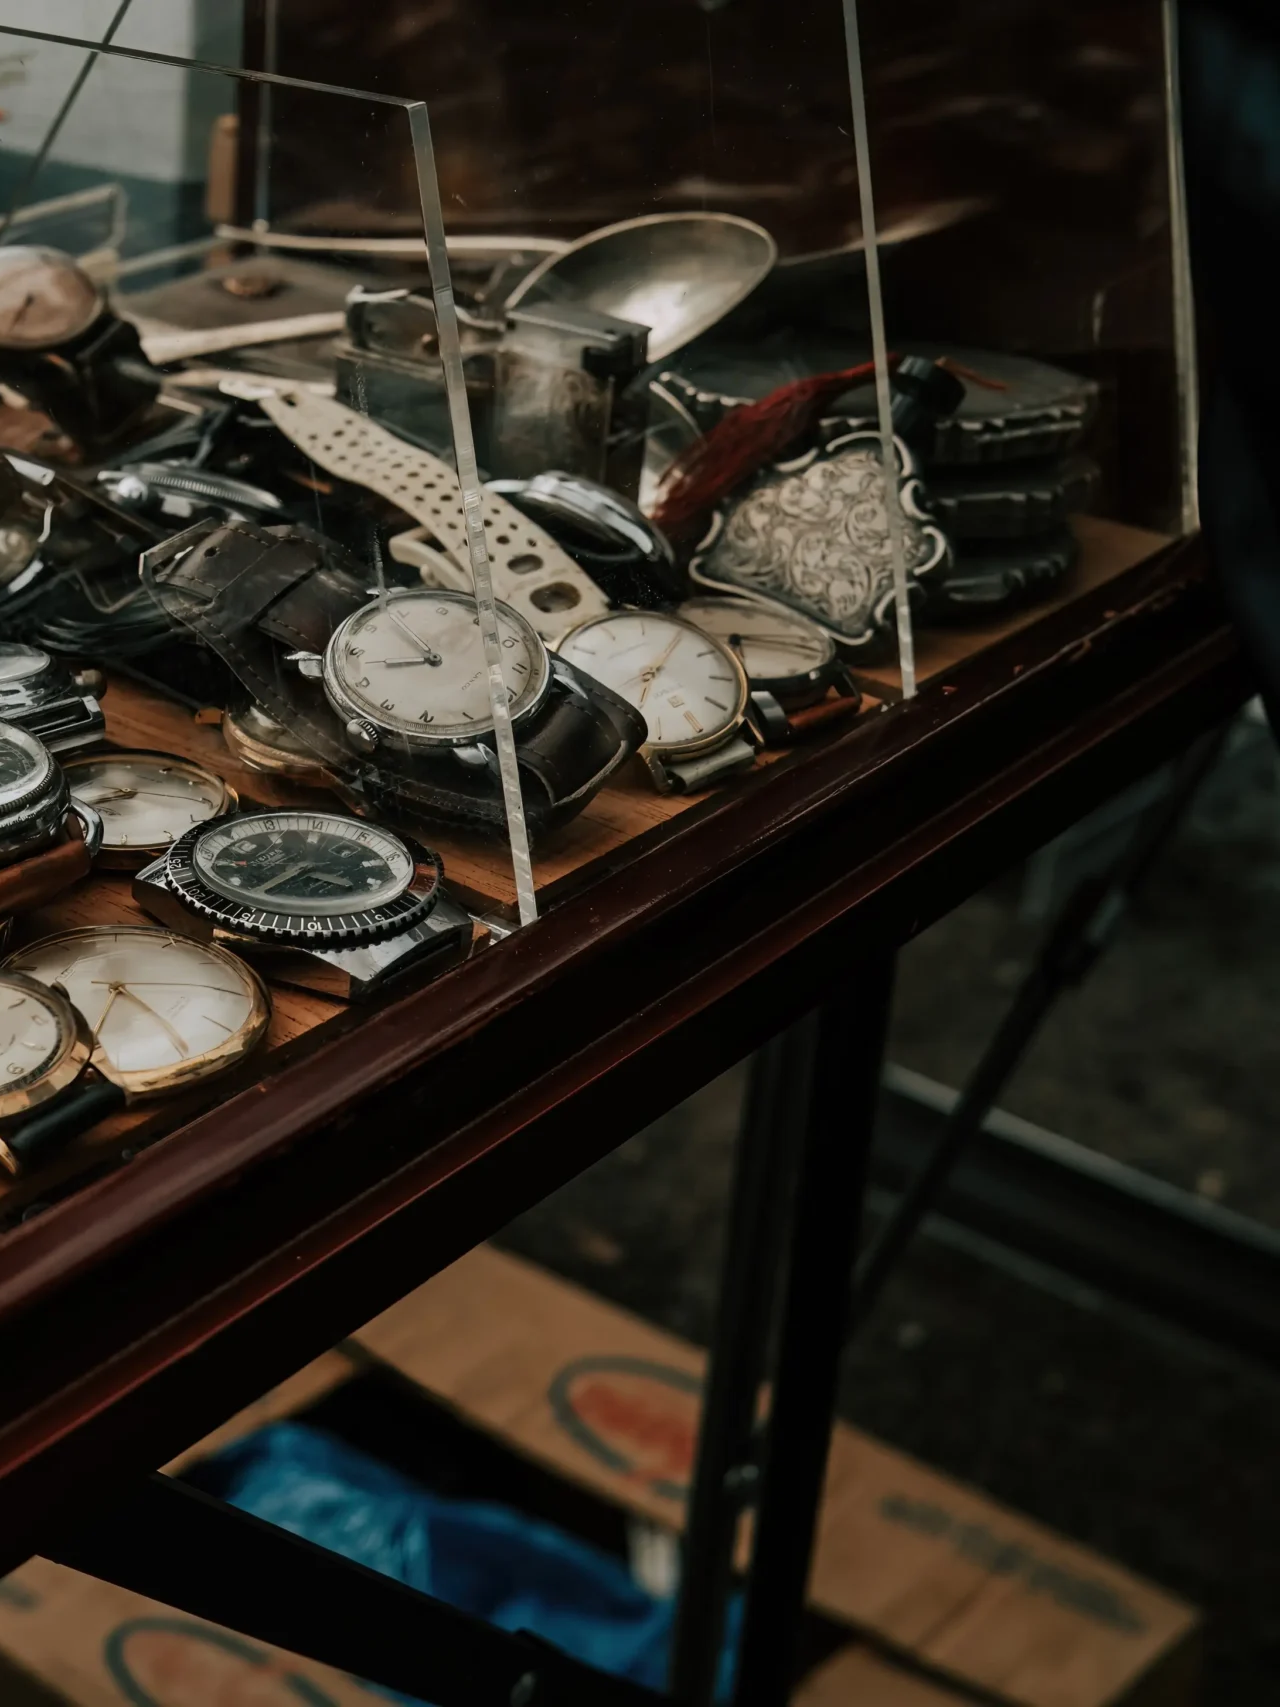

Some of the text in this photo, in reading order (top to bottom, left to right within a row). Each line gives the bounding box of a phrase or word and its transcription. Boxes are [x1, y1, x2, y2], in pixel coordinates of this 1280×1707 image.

[502, 635, 520, 649] 10
[380, 698, 395, 712] 3
[419, 710, 435, 724] 2
[169, 858, 182, 869] 25
[188, 887, 206, 900] 20
[307, 921, 323, 931] 10
